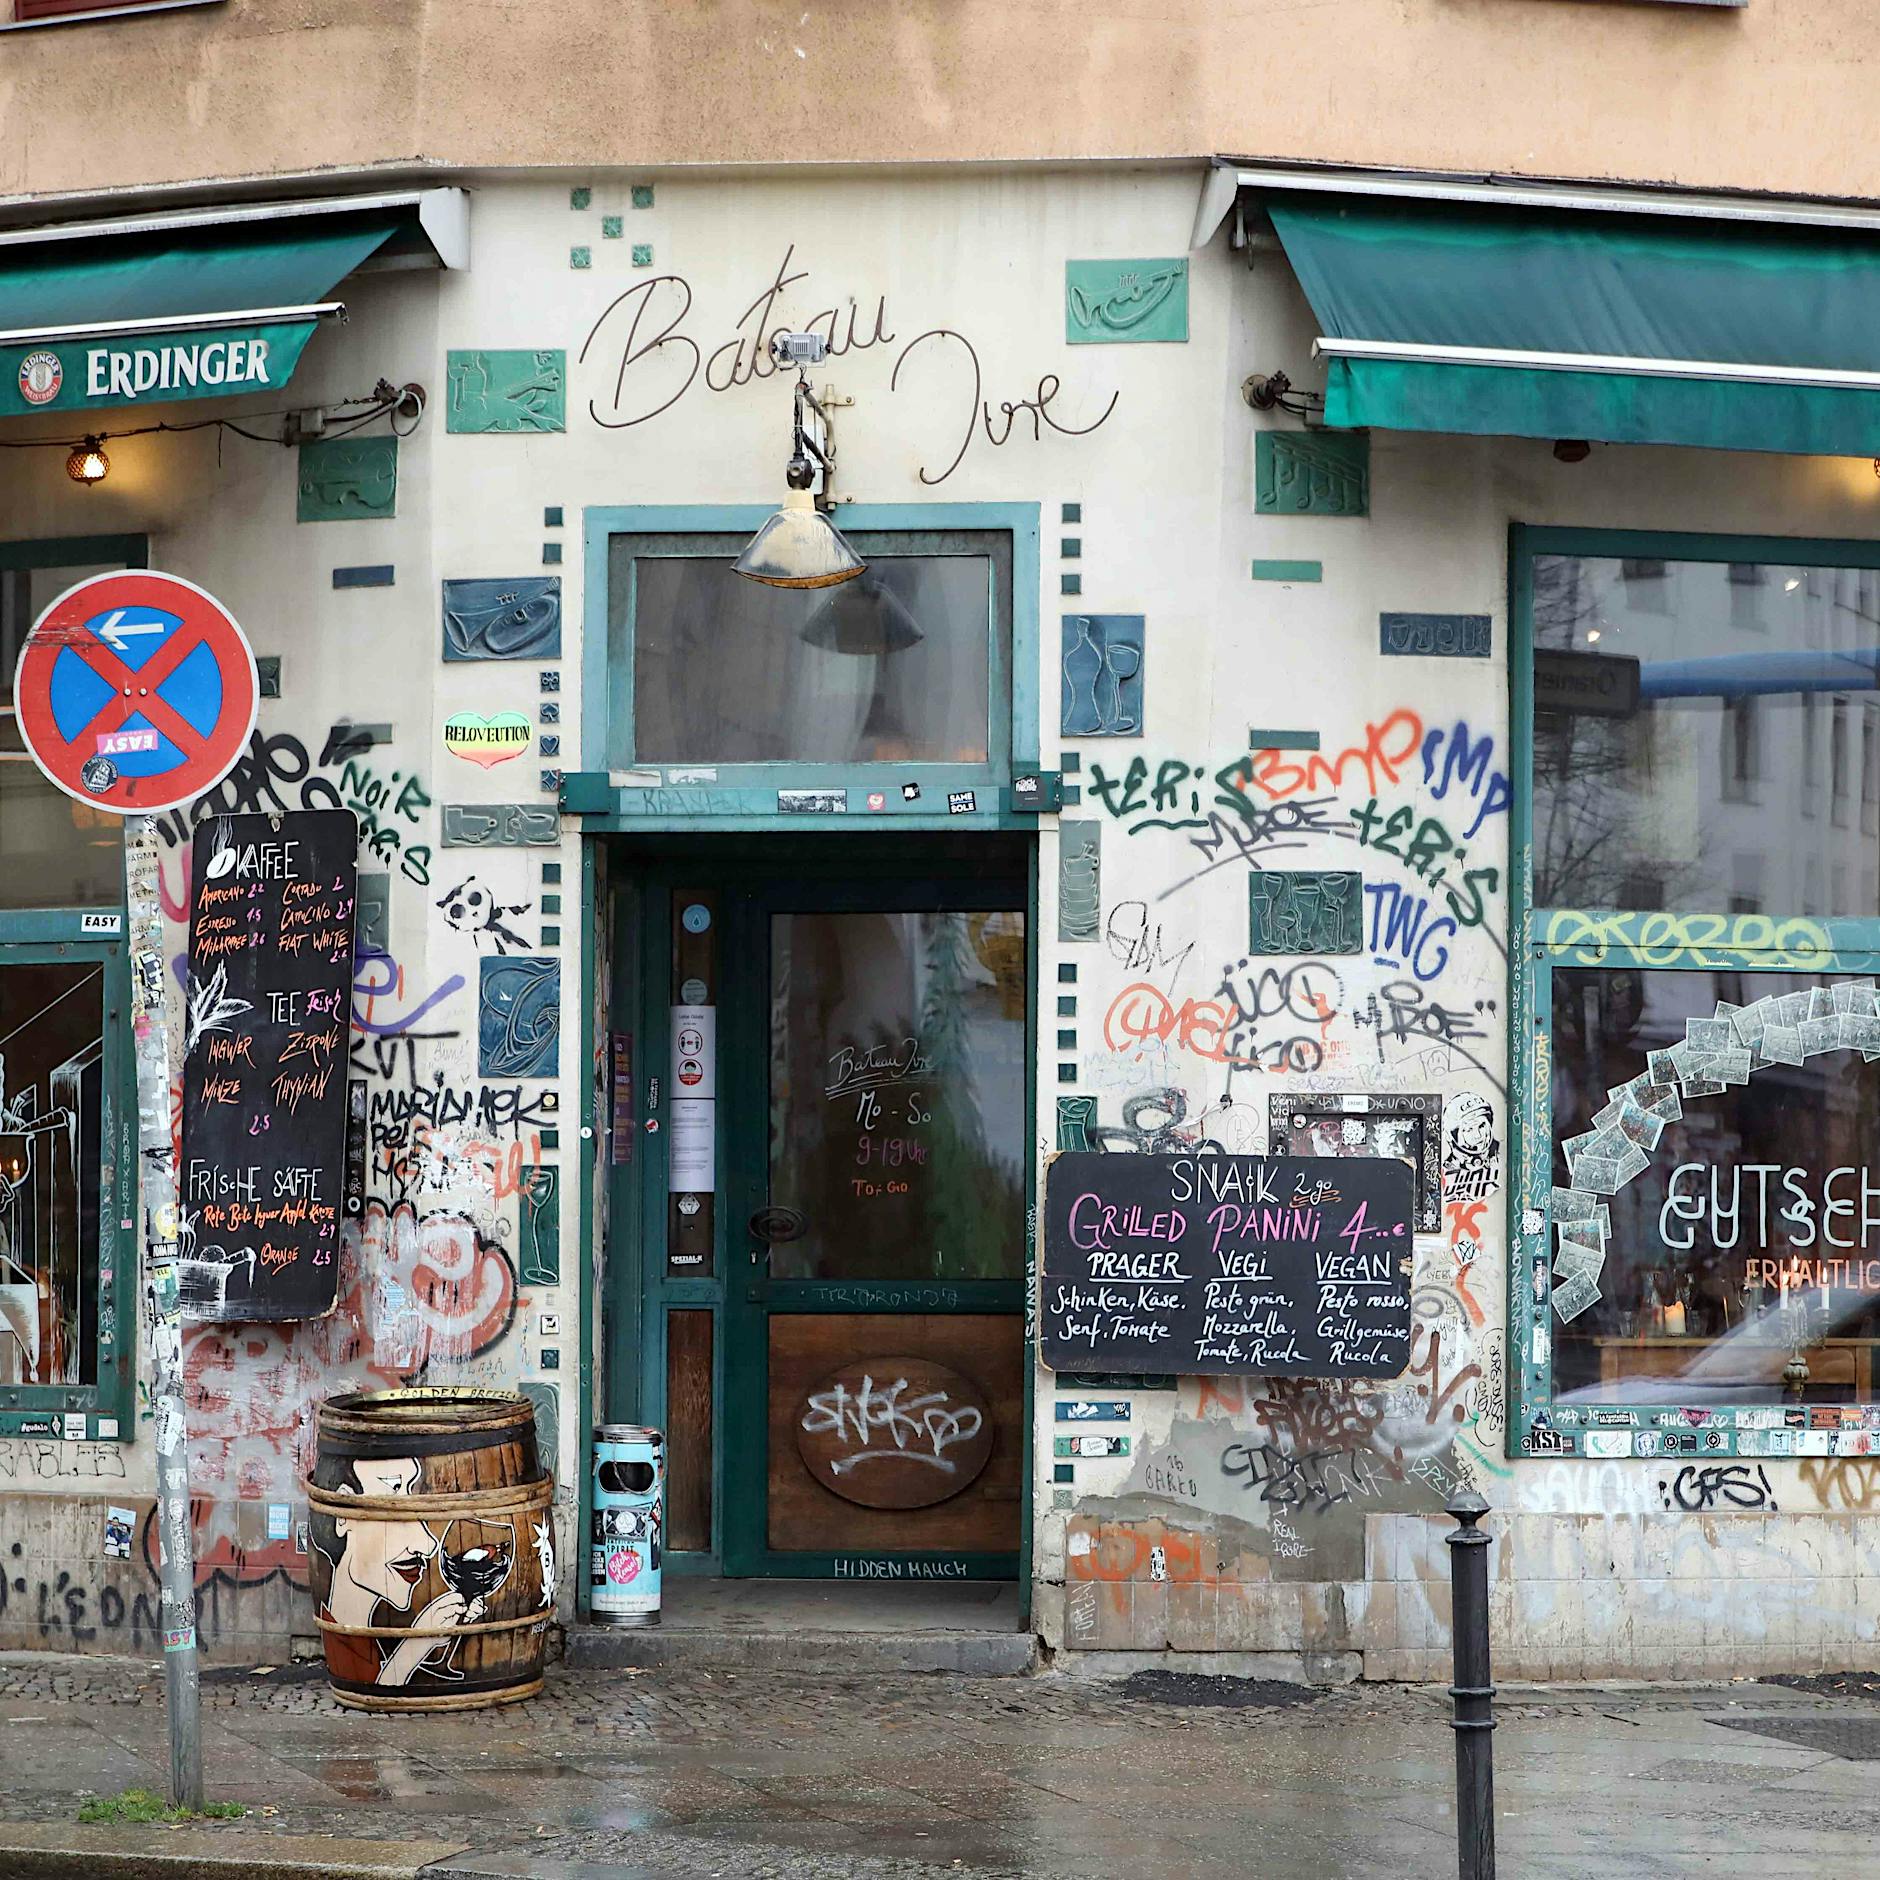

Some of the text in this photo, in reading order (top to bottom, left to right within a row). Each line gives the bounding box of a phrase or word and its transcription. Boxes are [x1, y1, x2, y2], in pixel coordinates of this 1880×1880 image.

[22, 354, 60, 376] ERDINGER
[87, 339, 270, 398] ERDINGER
[103, 735, 153, 754] EASY
[950, 792, 973, 802] SAME
[951, 803, 975, 813] SOLE
[235, 842, 299, 880] KAFFEE
[85, 916, 117, 927] EASY
[266, 992, 301, 1026] TEE
[856, 1090, 882, 1130] Mo
[907, 1092, 932, 1124] So
[1294, 1173, 1311, 1195] 2
[1310, 1180, 1332, 1205] go
[1087, 1252, 1192, 1280] PRAGER
[1315, 1251, 1391, 1281] VEGAN
[1204, 1283, 1243, 1314] Pesto
[1317, 1284, 1358, 1318] Pesto
[1329, 1342, 1393, 1365] Rucola
[1531, 1431, 1563, 1449] KST
[834, 1558, 901, 1577] HIDDEN
